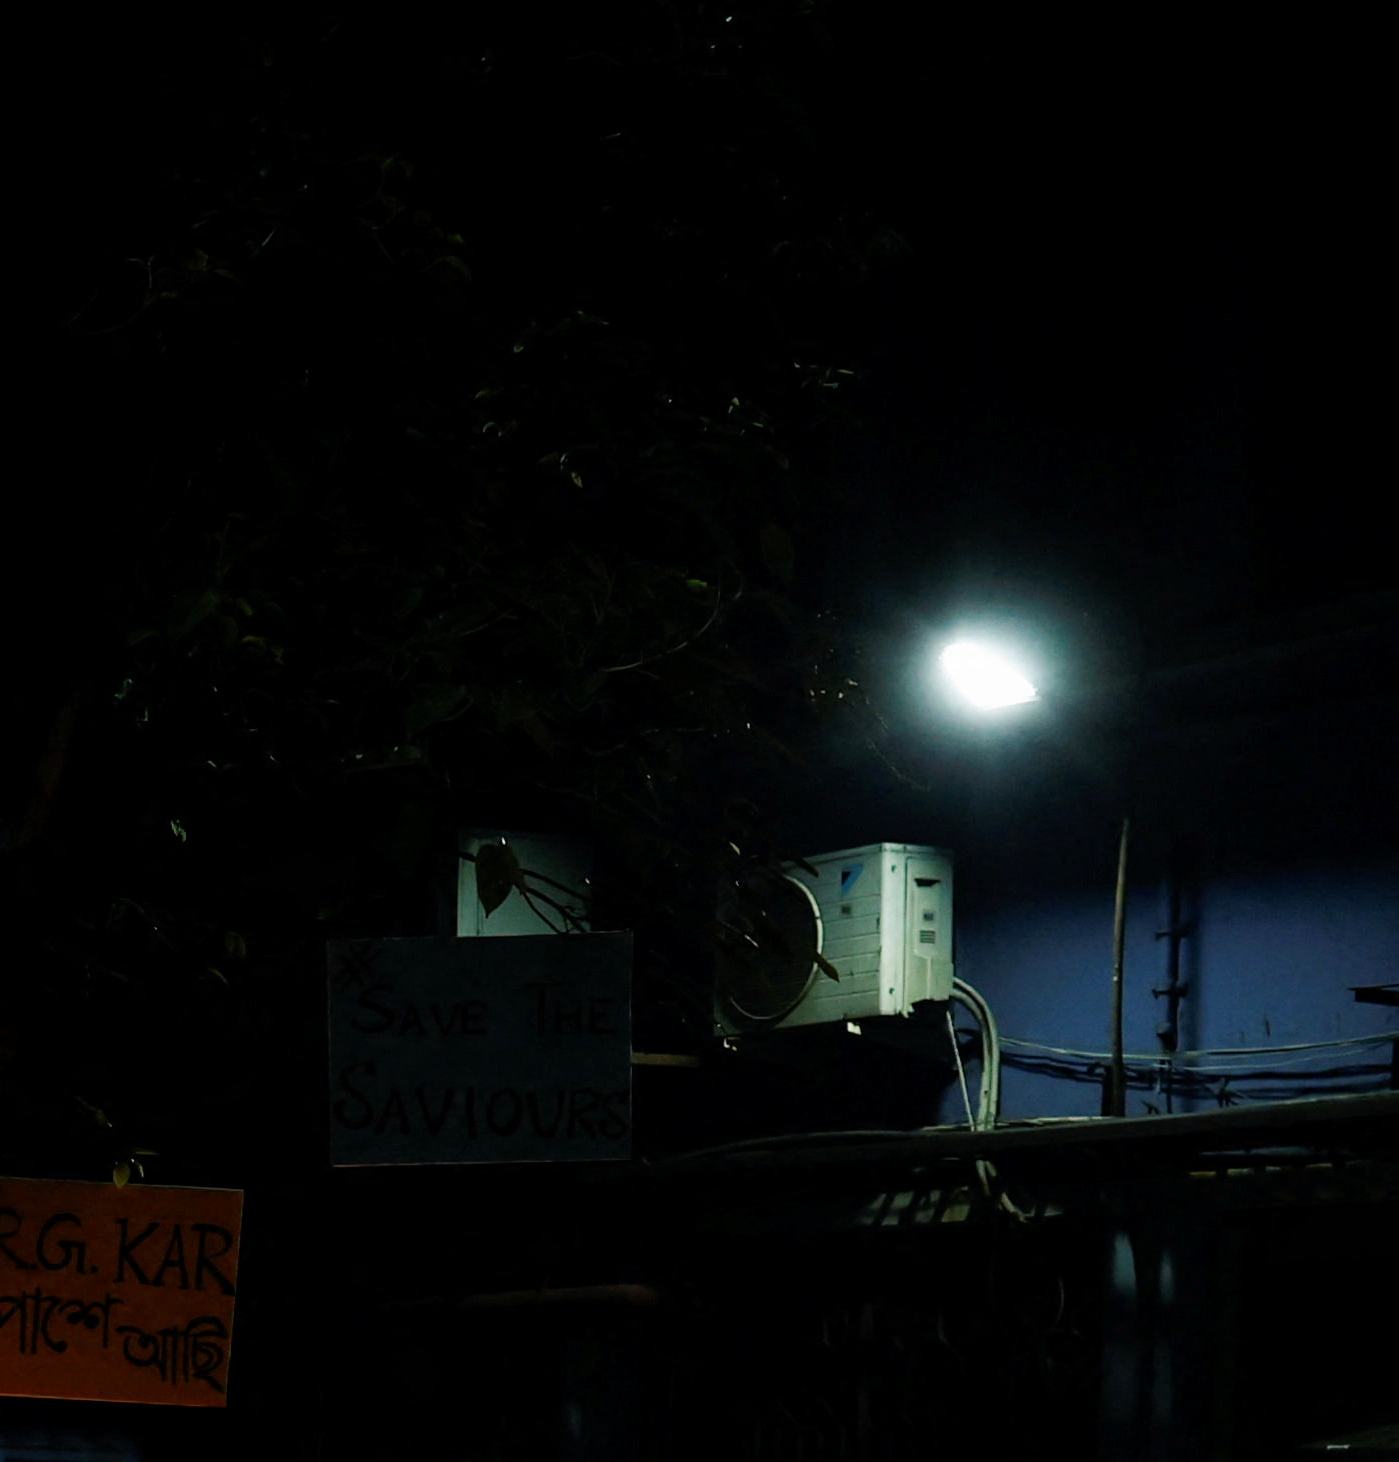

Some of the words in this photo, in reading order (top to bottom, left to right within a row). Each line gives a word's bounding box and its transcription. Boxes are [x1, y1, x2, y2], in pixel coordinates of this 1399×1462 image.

[351, 983, 488, 1036] SAVE
[524, 981, 616, 1036] THE
[333, 1061, 630, 1140] SAVIOURS
[112, 1217, 237, 1296] KAR
